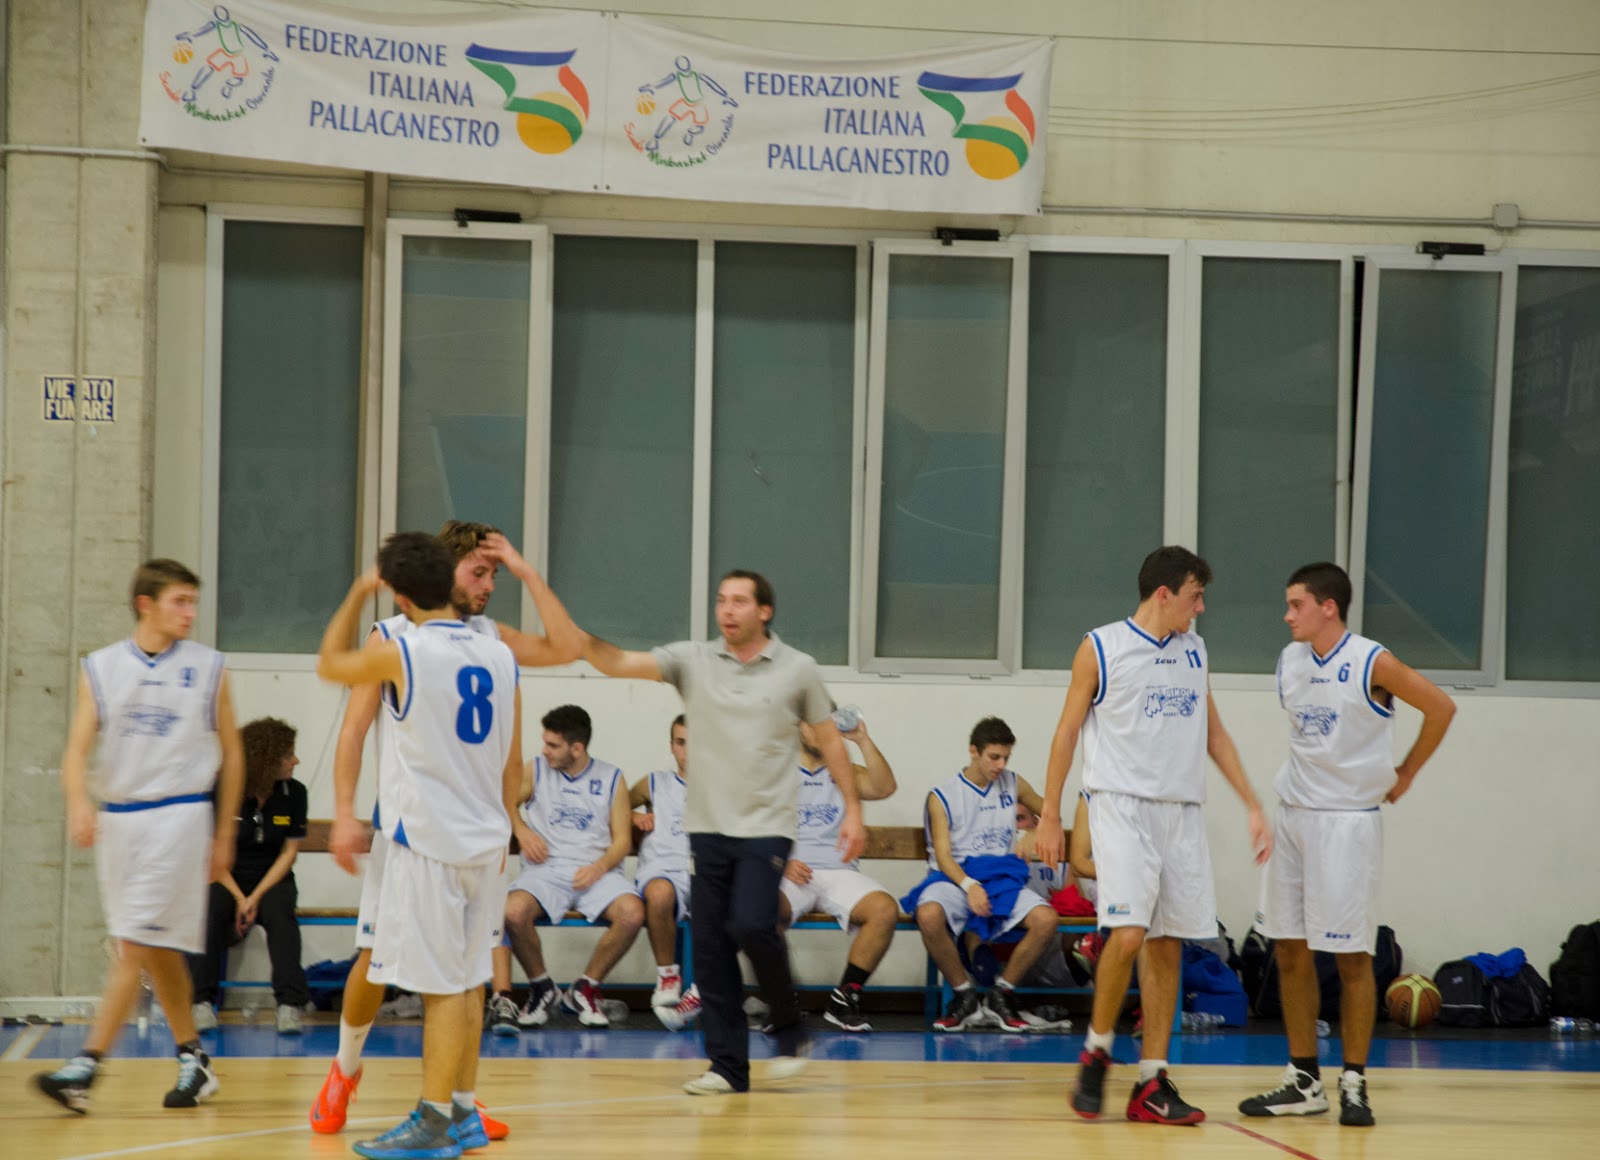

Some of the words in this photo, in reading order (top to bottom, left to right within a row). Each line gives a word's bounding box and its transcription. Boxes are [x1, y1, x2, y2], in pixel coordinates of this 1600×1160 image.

[285, 24, 448, 68] FEDERAZIONE
[368, 71, 474, 107] ITALIANA
[744, 71, 900, 99] FEDERAZIONE
[309, 100, 499, 147] PALLACANESTRO
[823, 108, 926, 137] ITALIANA
[767, 143, 949, 177] PALLACANESTRO
[1155, 657, 1178, 665] Zeus
[1338, 661, 1351, 683] 6
[456, 665, 494, 744] 8
[589, 779, 602, 795] 12
[999, 790, 1014, 809] 15
[1038, 867, 1053, 881] 10
